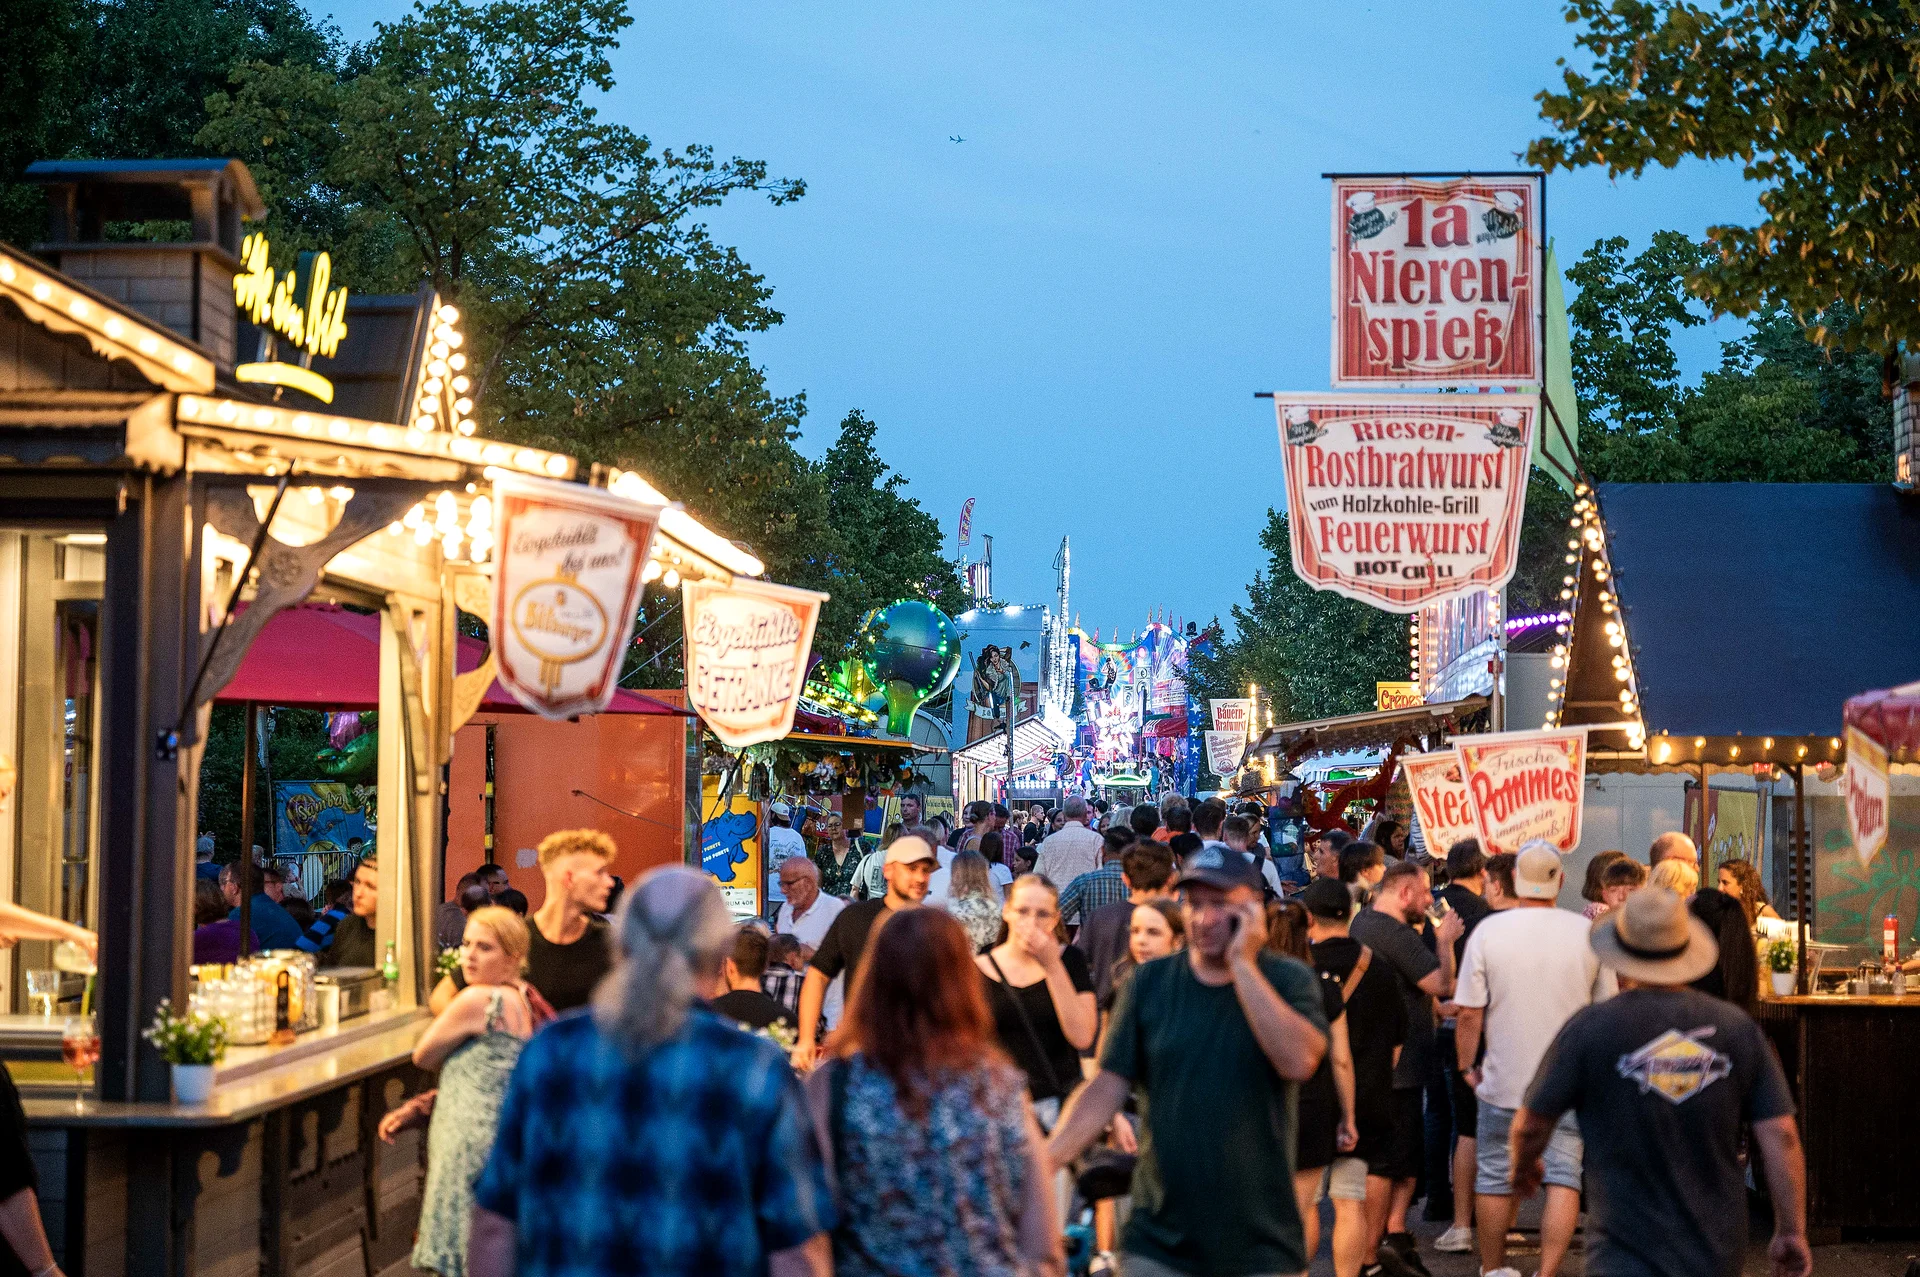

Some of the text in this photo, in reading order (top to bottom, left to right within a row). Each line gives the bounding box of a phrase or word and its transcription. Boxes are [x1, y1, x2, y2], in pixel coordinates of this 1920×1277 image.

[1402, 198, 1470, 248] 1a
[1350, 250, 1530, 304] Nieren-
[1367, 308, 1504, 370] spieß
[1352, 419, 1465, 443] Riesen-
[1305, 445, 1507, 490] Rostbratwurst
[1309, 494, 1479, 515] vom Holzkohle-Grill
[1318, 516, 1491, 555] Feuerwurst
[1355, 560, 1402, 576] HOT
[1215, 720, 1246, 731] Bratwurst
[1217, 707, 1245, 719] Bauern-
[1487, 747, 1554, 776] Frische
[1417, 786, 1475, 830] Stea
[1470, 766, 1579, 838] Pommes
[1495, 808, 1555, 839] immer ein
